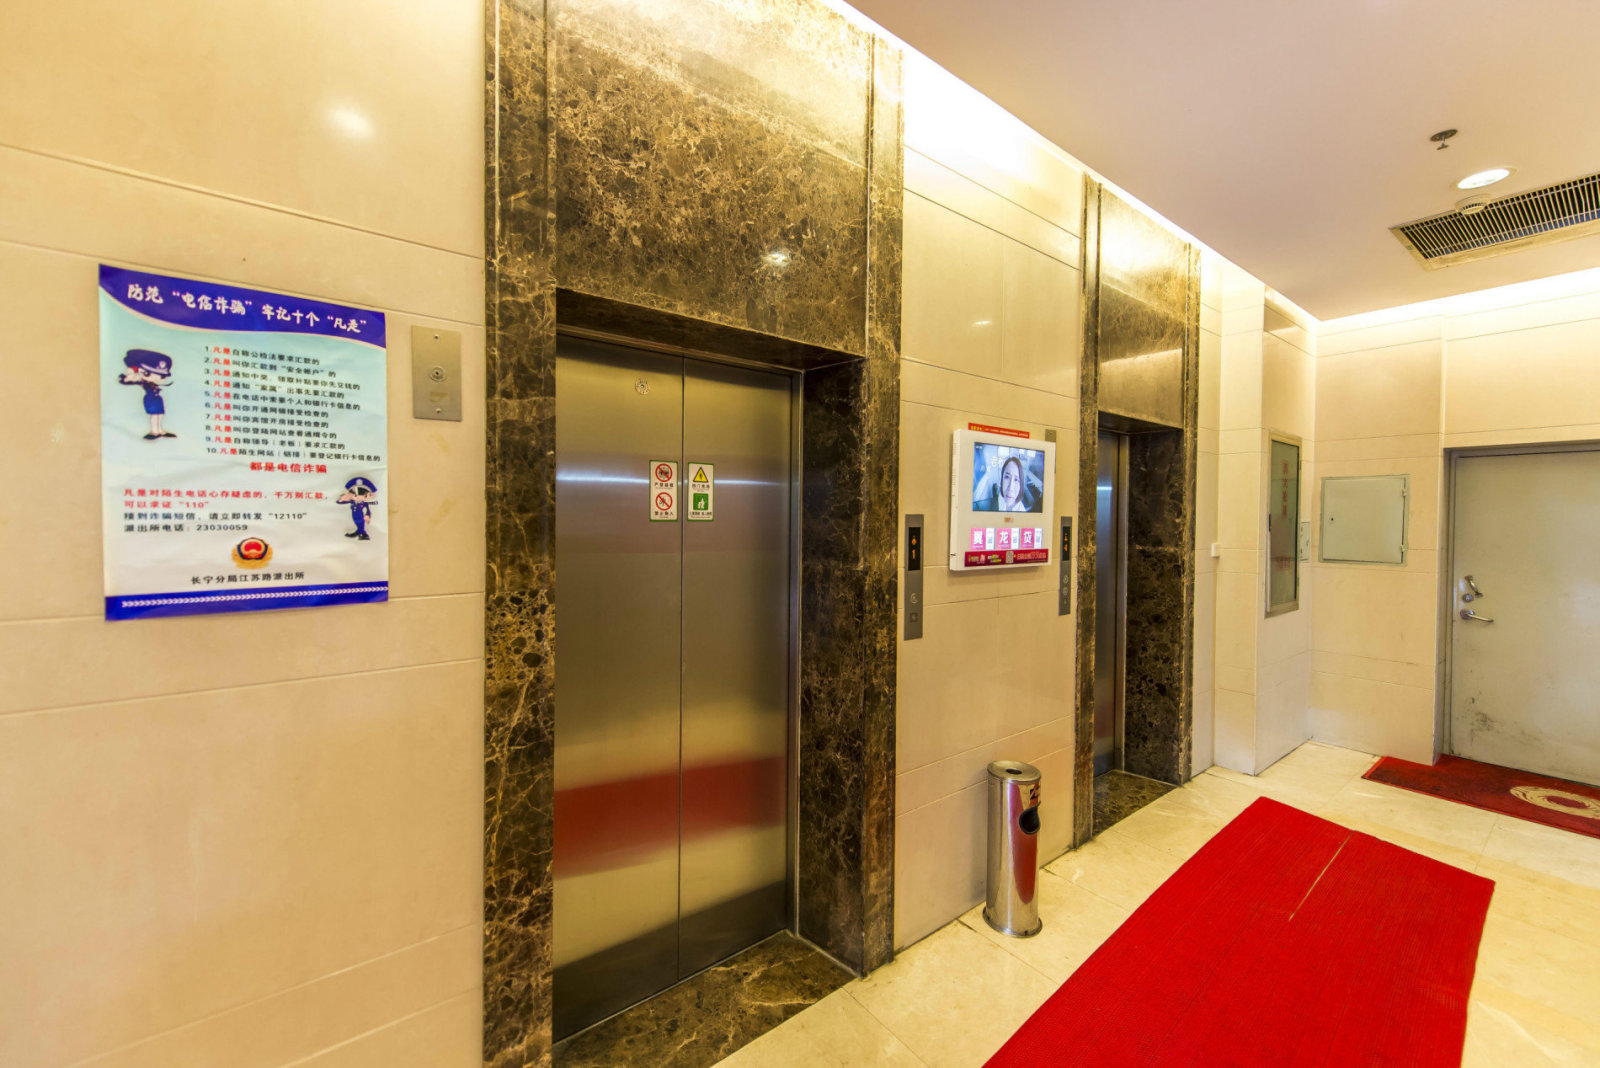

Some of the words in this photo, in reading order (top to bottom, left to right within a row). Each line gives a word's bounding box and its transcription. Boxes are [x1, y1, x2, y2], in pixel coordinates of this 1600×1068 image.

[249, 461, 328, 474] 都是电信诈骗
[999, 530, 1009, 544] 龙
[1023, 531, 1033, 544] 贷
[190, 571, 305, 585] 长宁分局江苏路派出所
